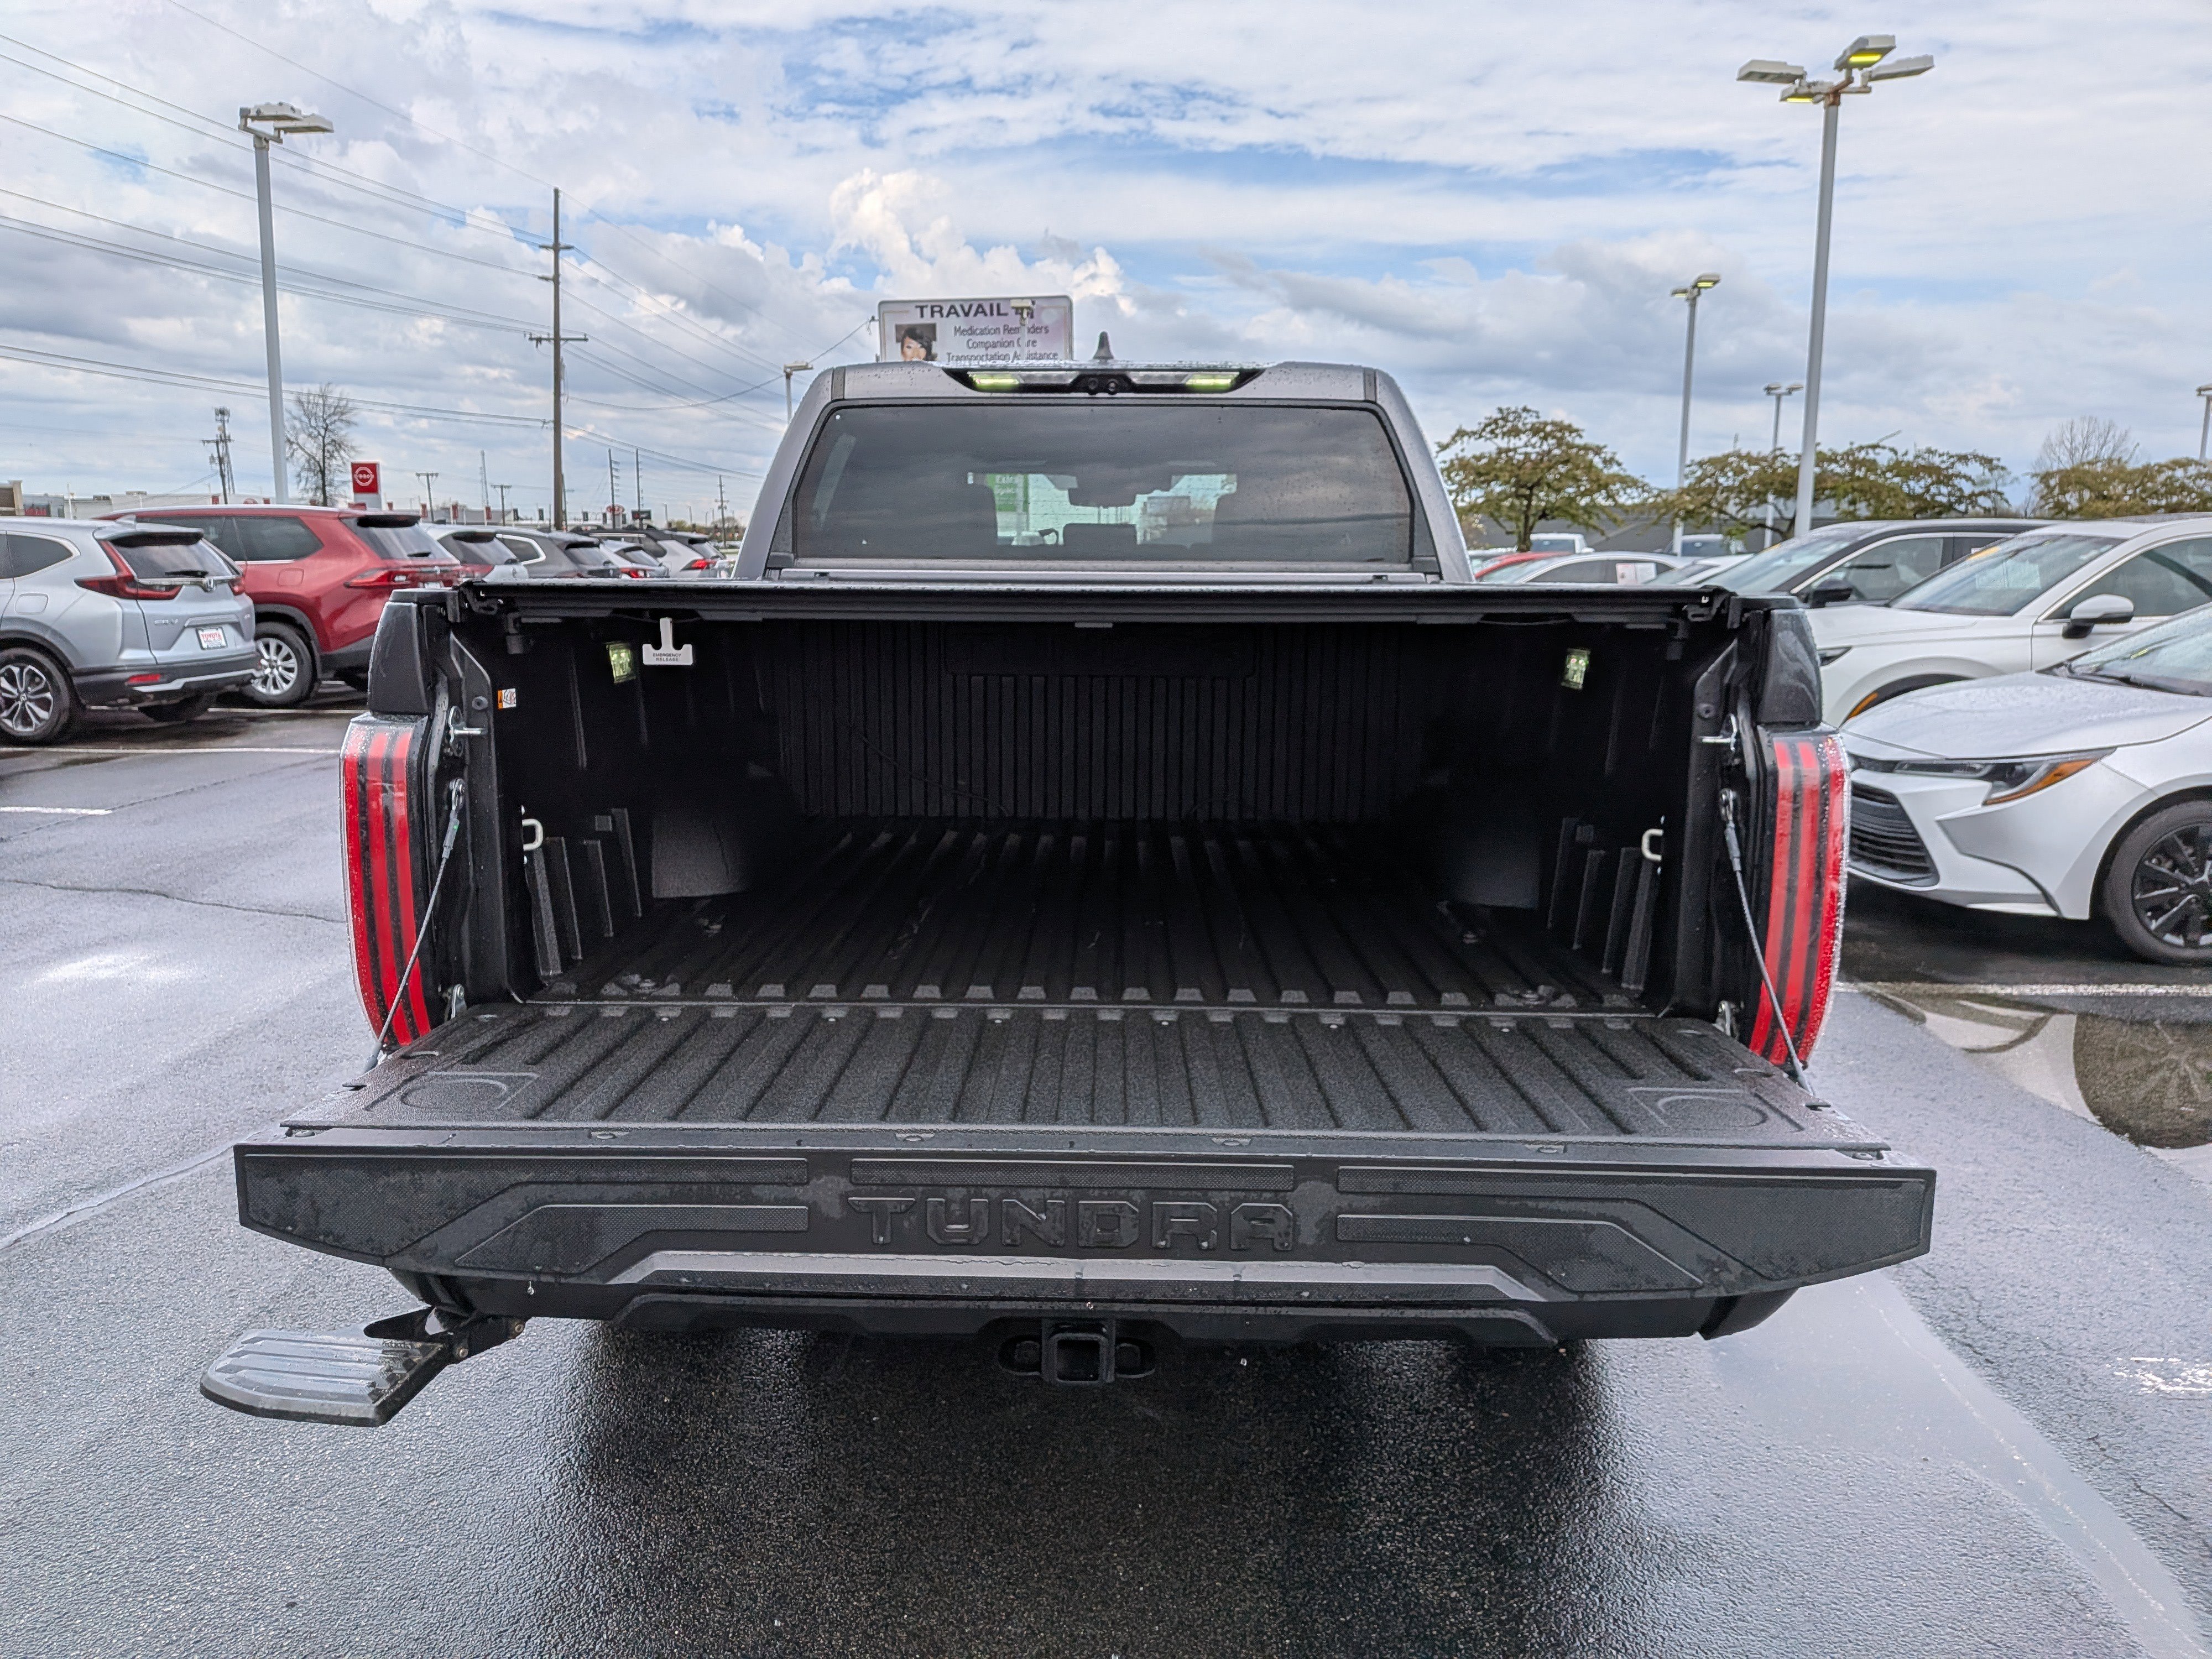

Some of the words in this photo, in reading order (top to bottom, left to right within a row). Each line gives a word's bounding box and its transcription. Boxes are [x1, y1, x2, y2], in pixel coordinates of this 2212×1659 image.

[915, 302, 1009, 319] TRAVAIL
[954, 325, 1000, 337] Medication
[967, 337, 1015, 351] Companion
[1016, 337, 1037, 348] Cre
[847, 1197, 1293, 1251] TUNDRA
